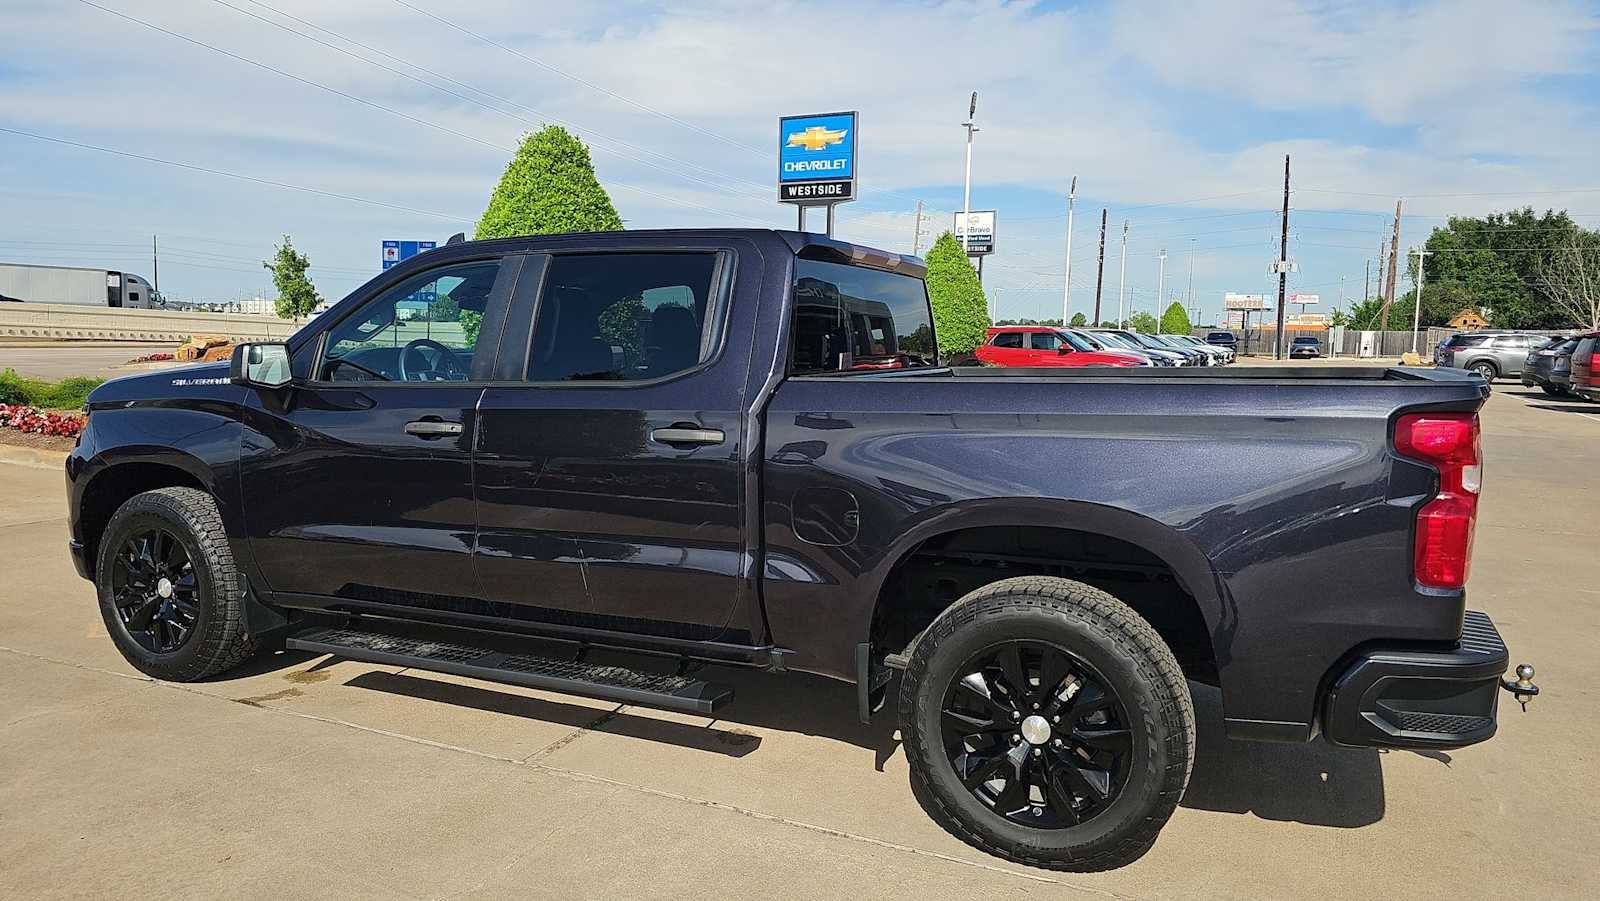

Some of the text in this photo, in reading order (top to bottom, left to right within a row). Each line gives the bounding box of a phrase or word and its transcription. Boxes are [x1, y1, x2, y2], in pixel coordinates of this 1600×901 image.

[784, 158, 848, 172] CHEVROLET
[788, 184, 843, 196] WESTSIDE
[957, 226, 990, 234] CrBravo
